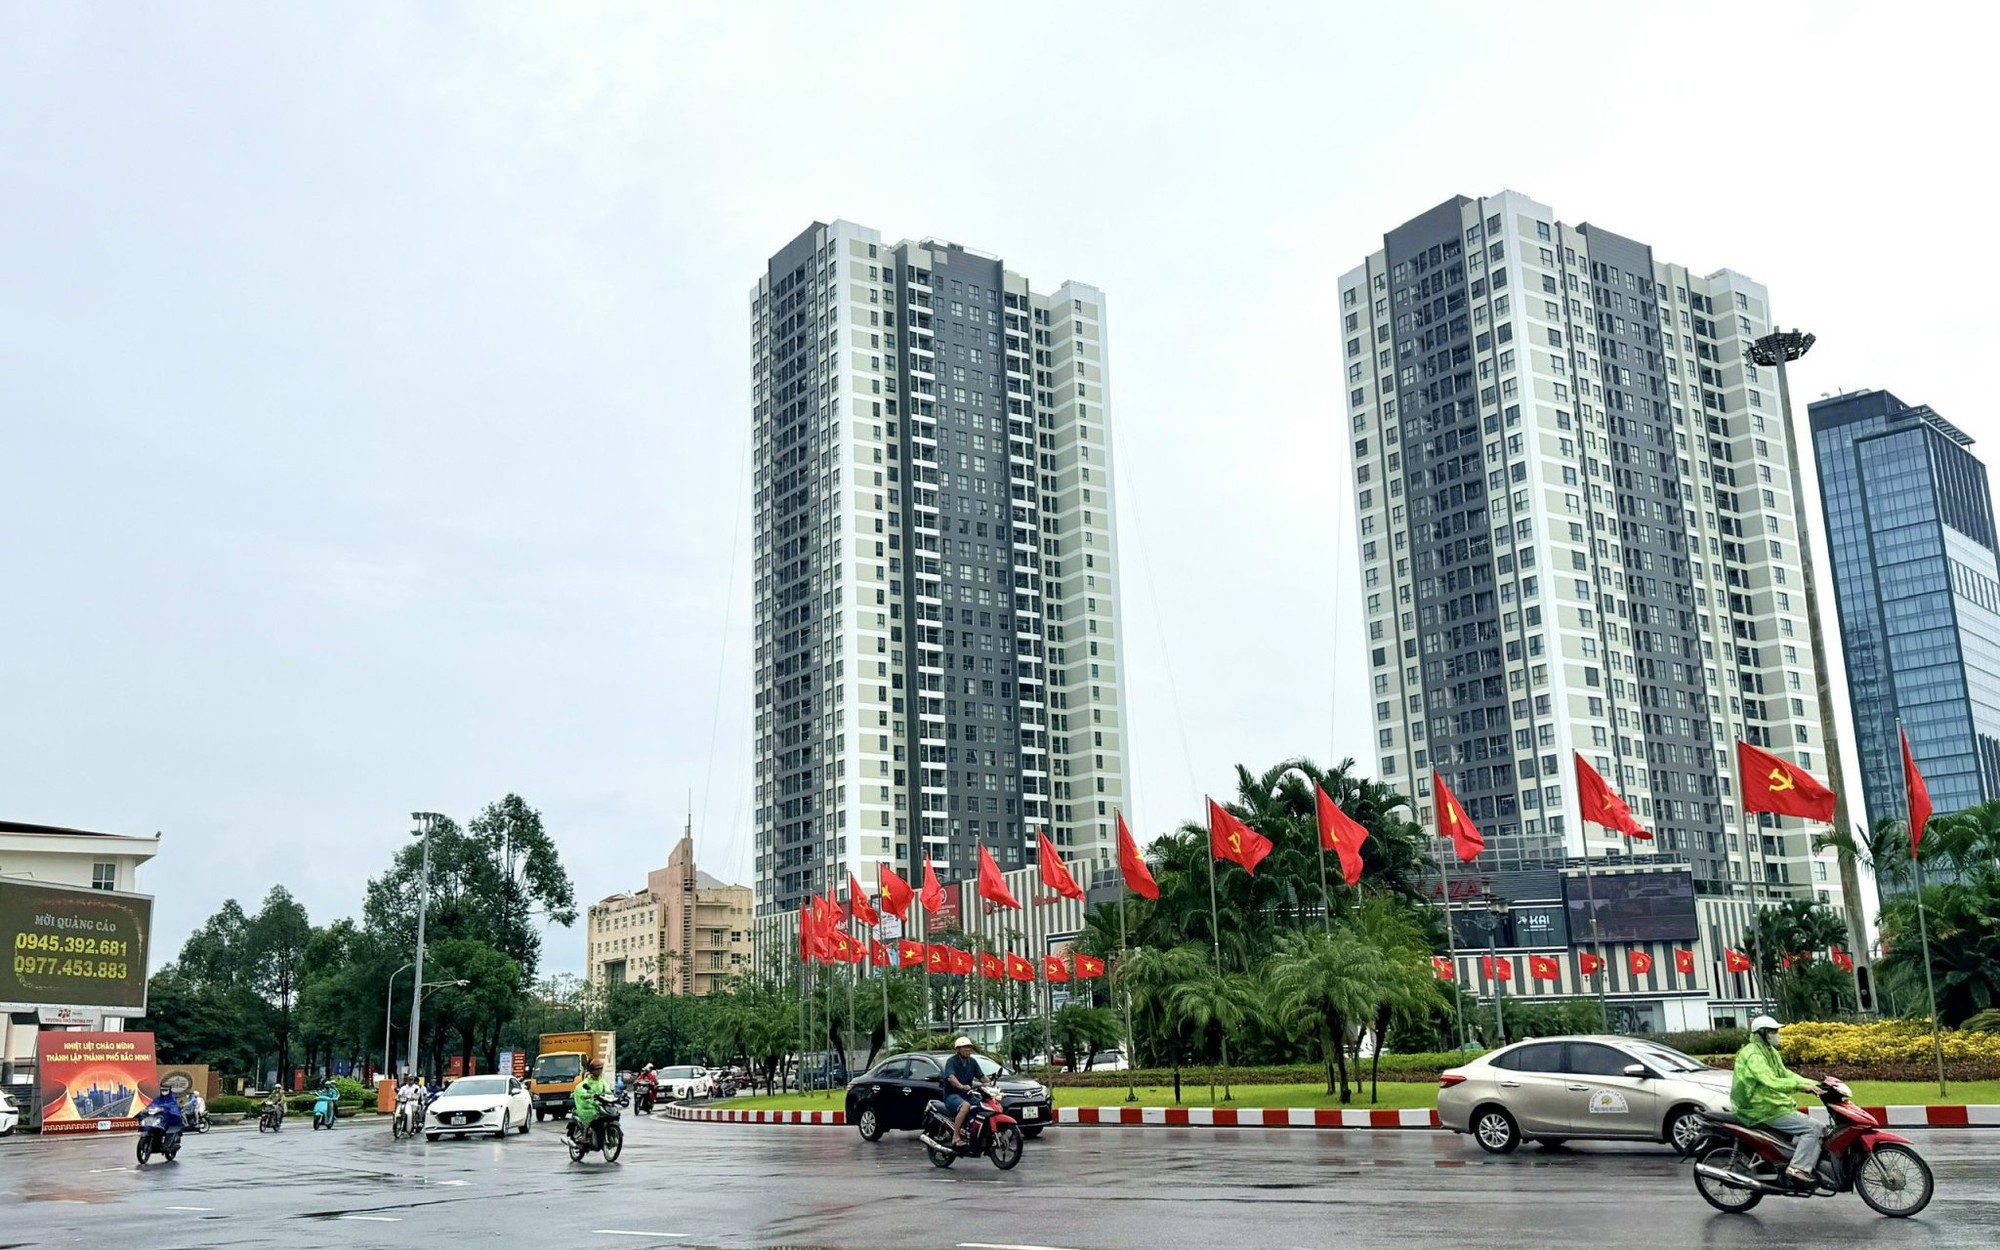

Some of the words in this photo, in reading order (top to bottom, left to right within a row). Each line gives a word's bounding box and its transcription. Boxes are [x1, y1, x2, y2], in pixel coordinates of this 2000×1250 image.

[35, 913, 55, 926] MỜI
[57, 915, 94, 930] QUẢNG
[95, 919, 117, 932] CÁO
[1529, 915, 1550, 925] KAI
[16, 932, 127, 957] 0945.392.681
[14, 955, 127, 979] 0977.453.883
